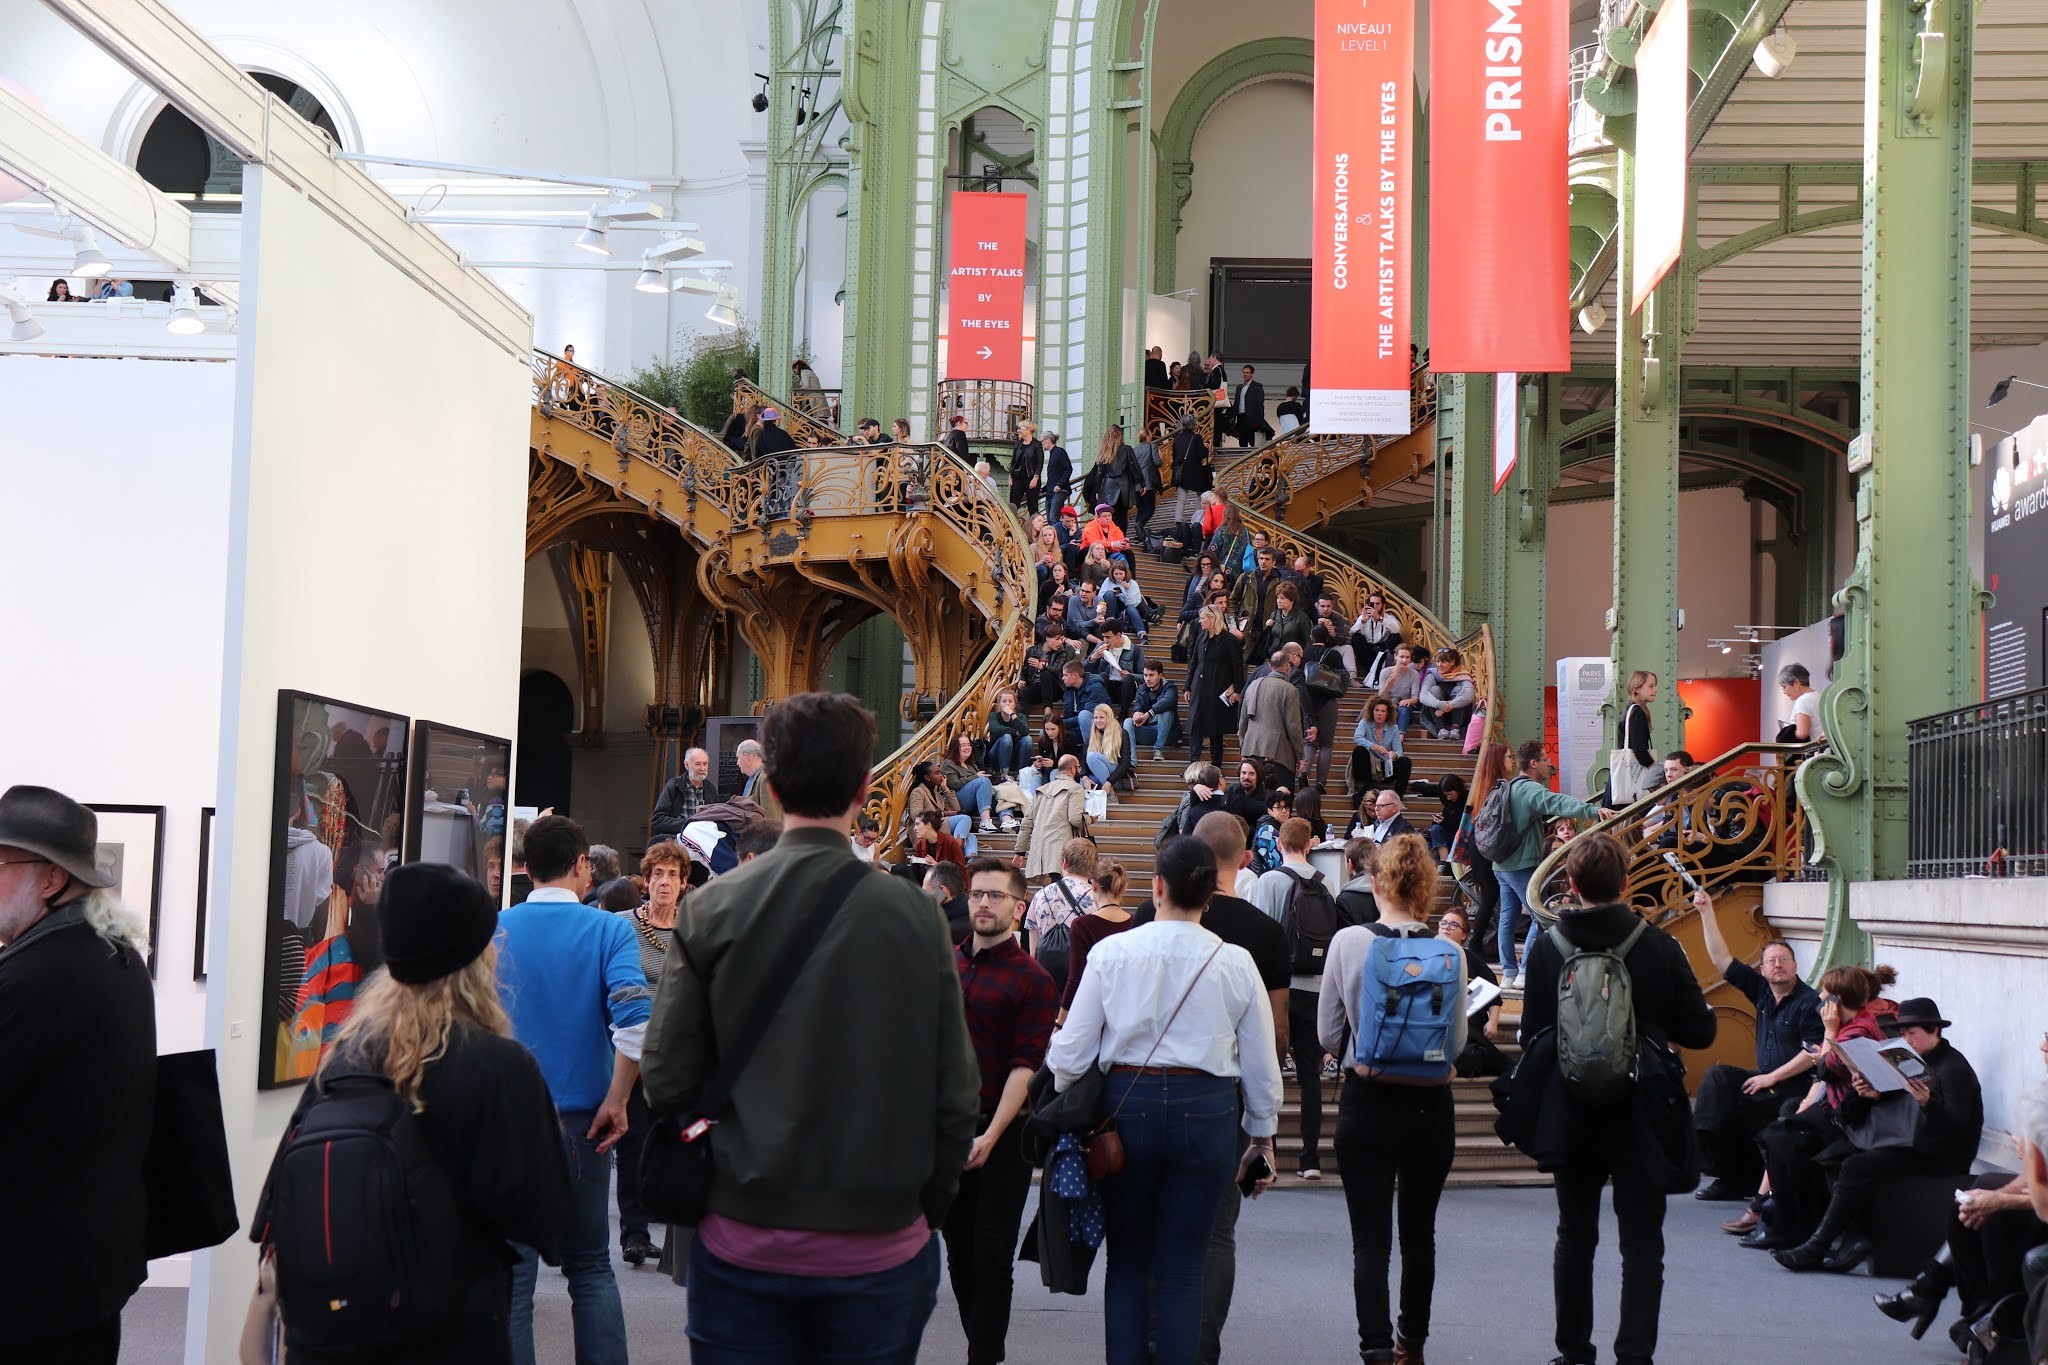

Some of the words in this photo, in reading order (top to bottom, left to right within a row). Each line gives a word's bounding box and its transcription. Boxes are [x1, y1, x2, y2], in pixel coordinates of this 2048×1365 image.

[1337, 23, 1385, 35] NIVEAU
[1386, 23, 1392, 35] 1
[1341, 40, 1380, 52] LEVEL
[1382, 40, 1387, 51] 1
[1485, 0, 1523, 141] PRISM
[1381, 81, 1396, 125] EYES
[1380, 129, 1396, 165] THE
[1380, 167, 1395, 192] BY
[1333, 153, 1349, 290] CONVERSATIONS
[1379, 195, 1395, 253] TALKS
[977, 241, 998, 251] THE
[950, 267, 988, 276] ARTIST
[989, 267, 1024, 277] TALKS
[977, 293, 992, 303] BY
[1379, 256, 1394, 320] ARTIST
[961, 319, 982, 328] THE
[984, 319, 1010, 329] EYES
[1378, 323, 1394, 359] THE
[1991, 514, 2010, 533] HUAWEI
